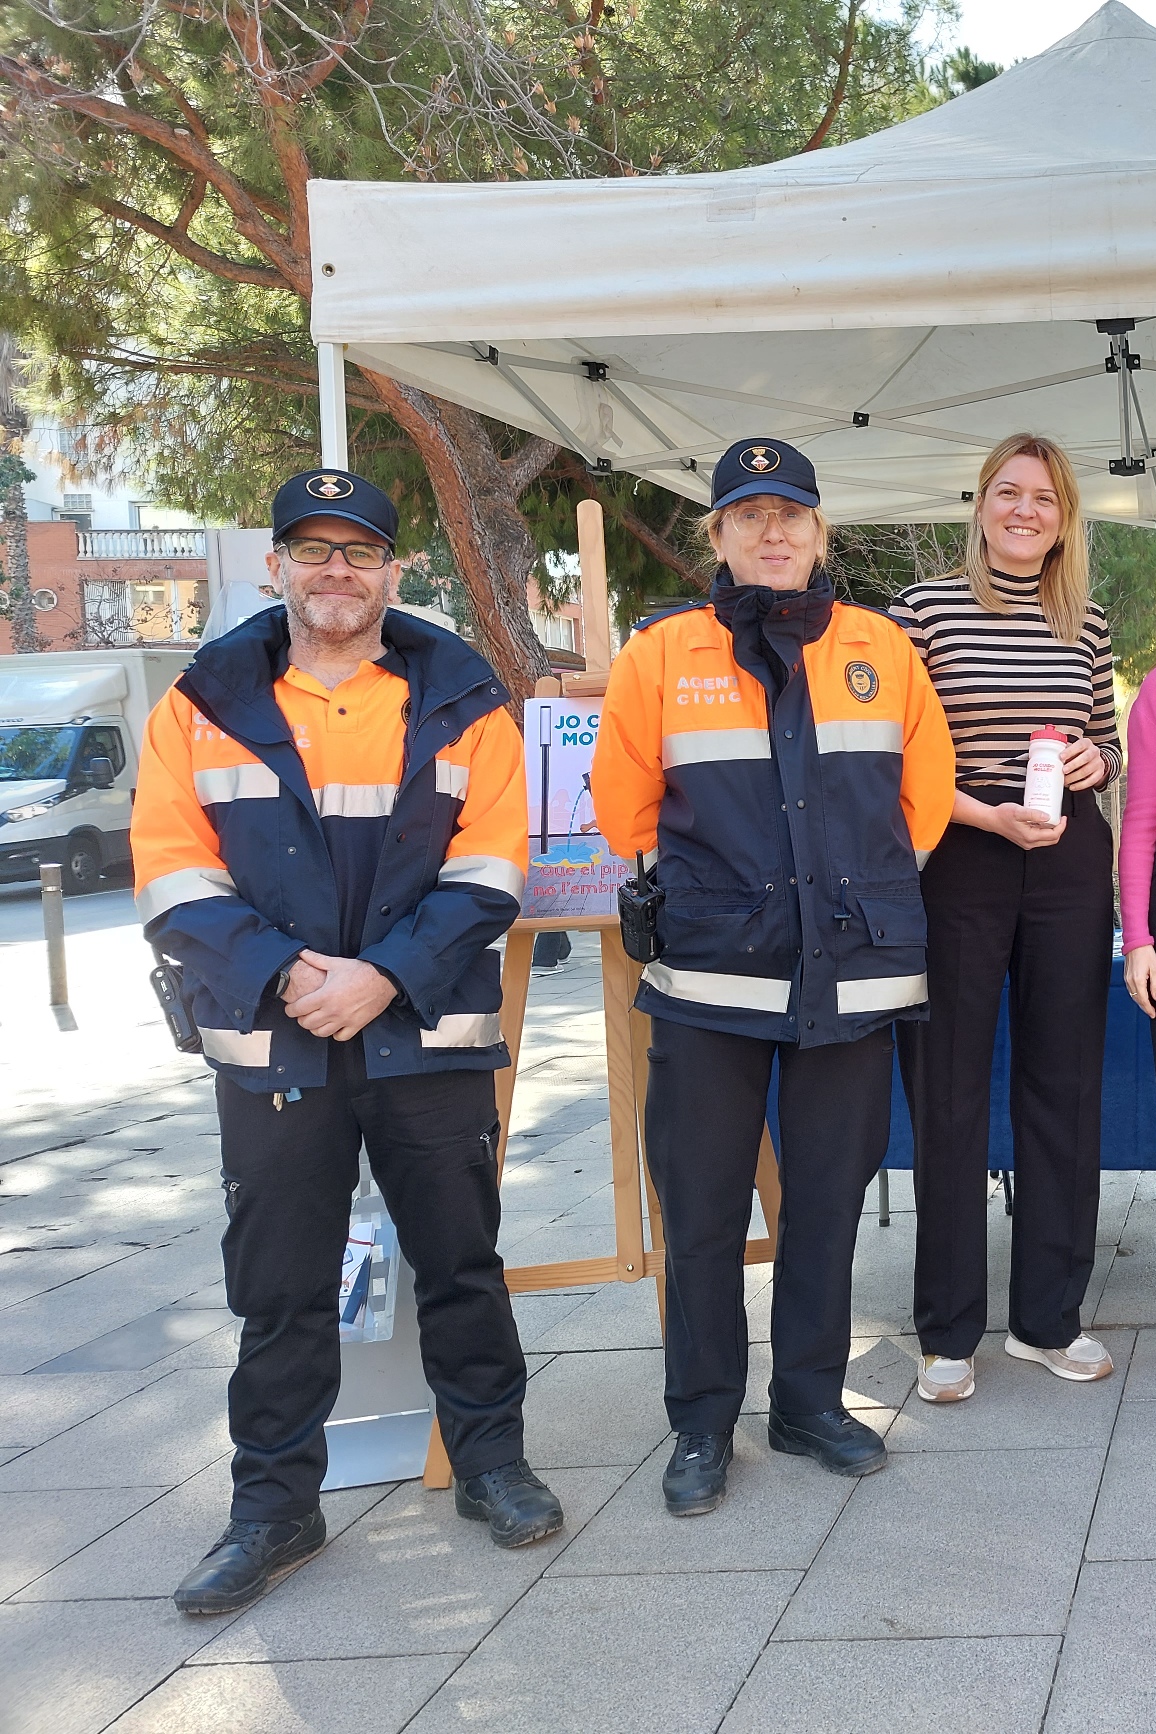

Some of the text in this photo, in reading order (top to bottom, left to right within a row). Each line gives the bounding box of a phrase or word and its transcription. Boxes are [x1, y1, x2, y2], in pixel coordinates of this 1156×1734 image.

[677, 676, 739, 690] AGENT
[554, 714, 580, 730] JO
[540, 862, 632, 879] Que el pip
[533, 885, 557, 897] no
